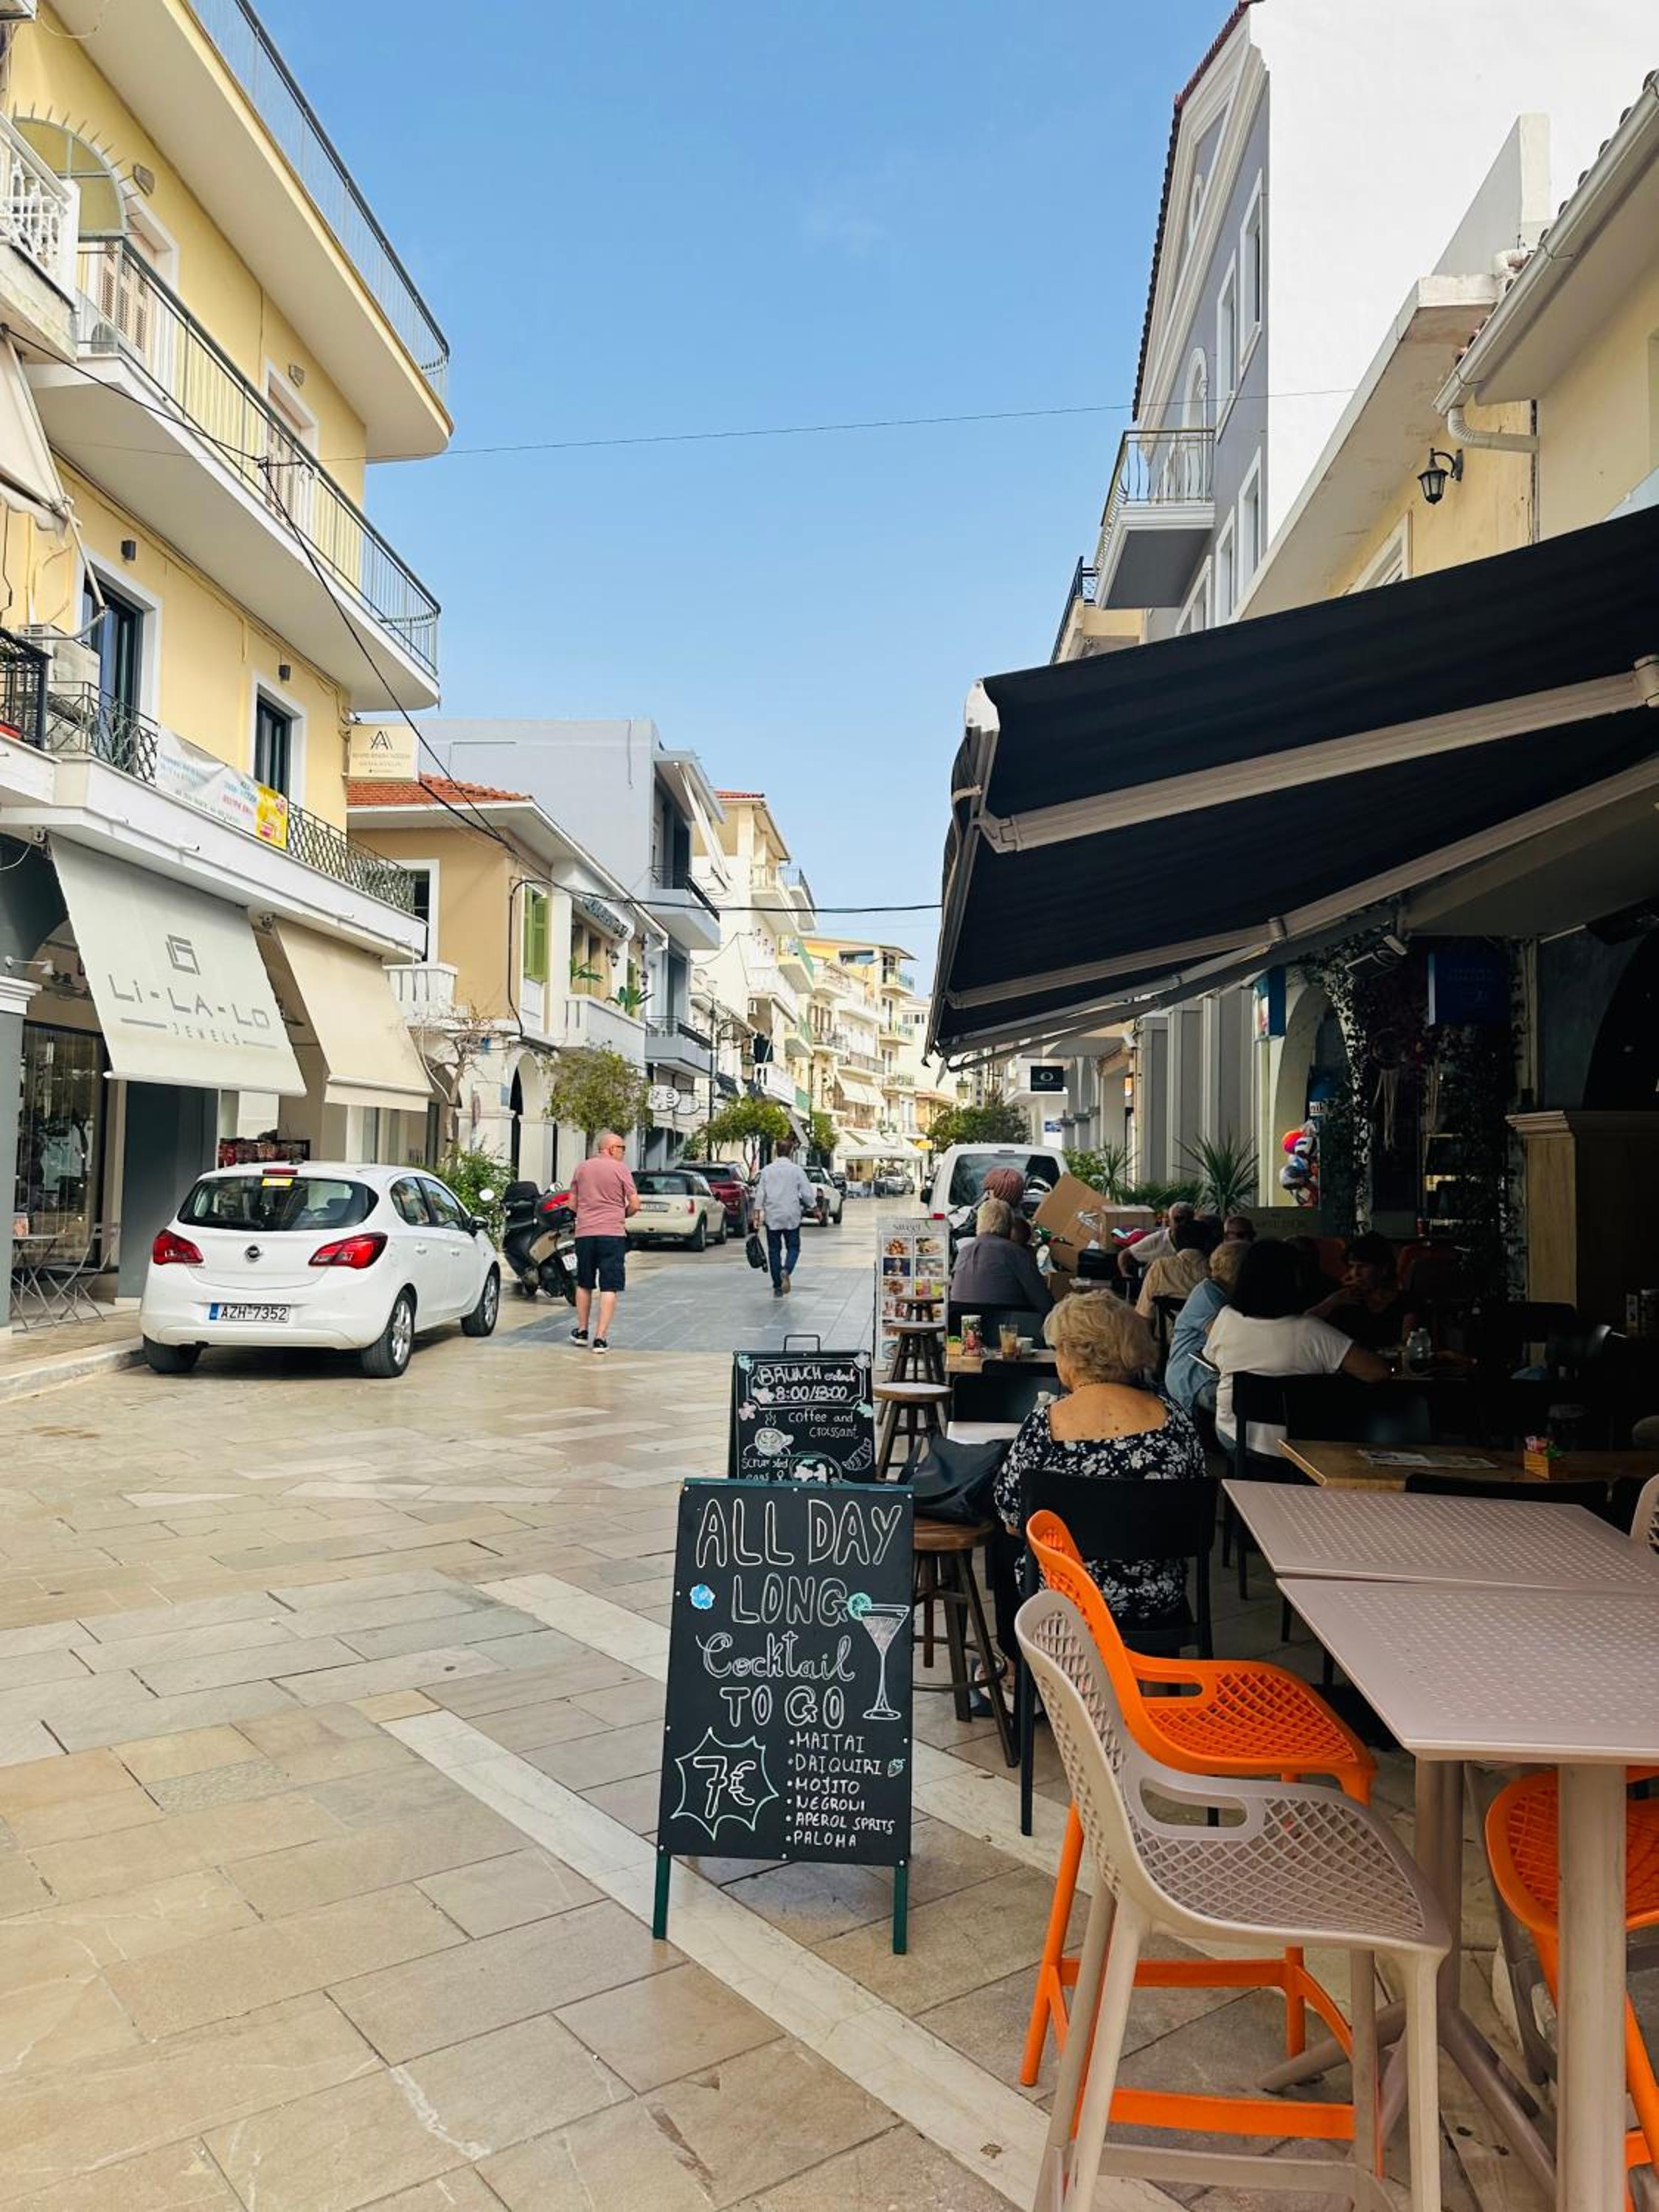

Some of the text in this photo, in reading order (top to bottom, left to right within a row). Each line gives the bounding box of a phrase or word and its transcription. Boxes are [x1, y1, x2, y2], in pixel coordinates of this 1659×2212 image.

[757, 1366, 821, 1385] BRUNCH
[788, 1409, 853, 1422] coffee and
[696, 1498, 902, 1568] ALL DAY
[731, 1573, 848, 1627] LONG
[696, 1631, 855, 1681] Cocktail
[720, 1686, 845, 1729] TO GO
[796, 1753, 882, 1775] DAIQUIRI
[692, 1756, 757, 1818] 7€
[796, 1795, 865, 1812] NEGRONI
[796, 1812, 895, 1835] APEROL SPRITS
